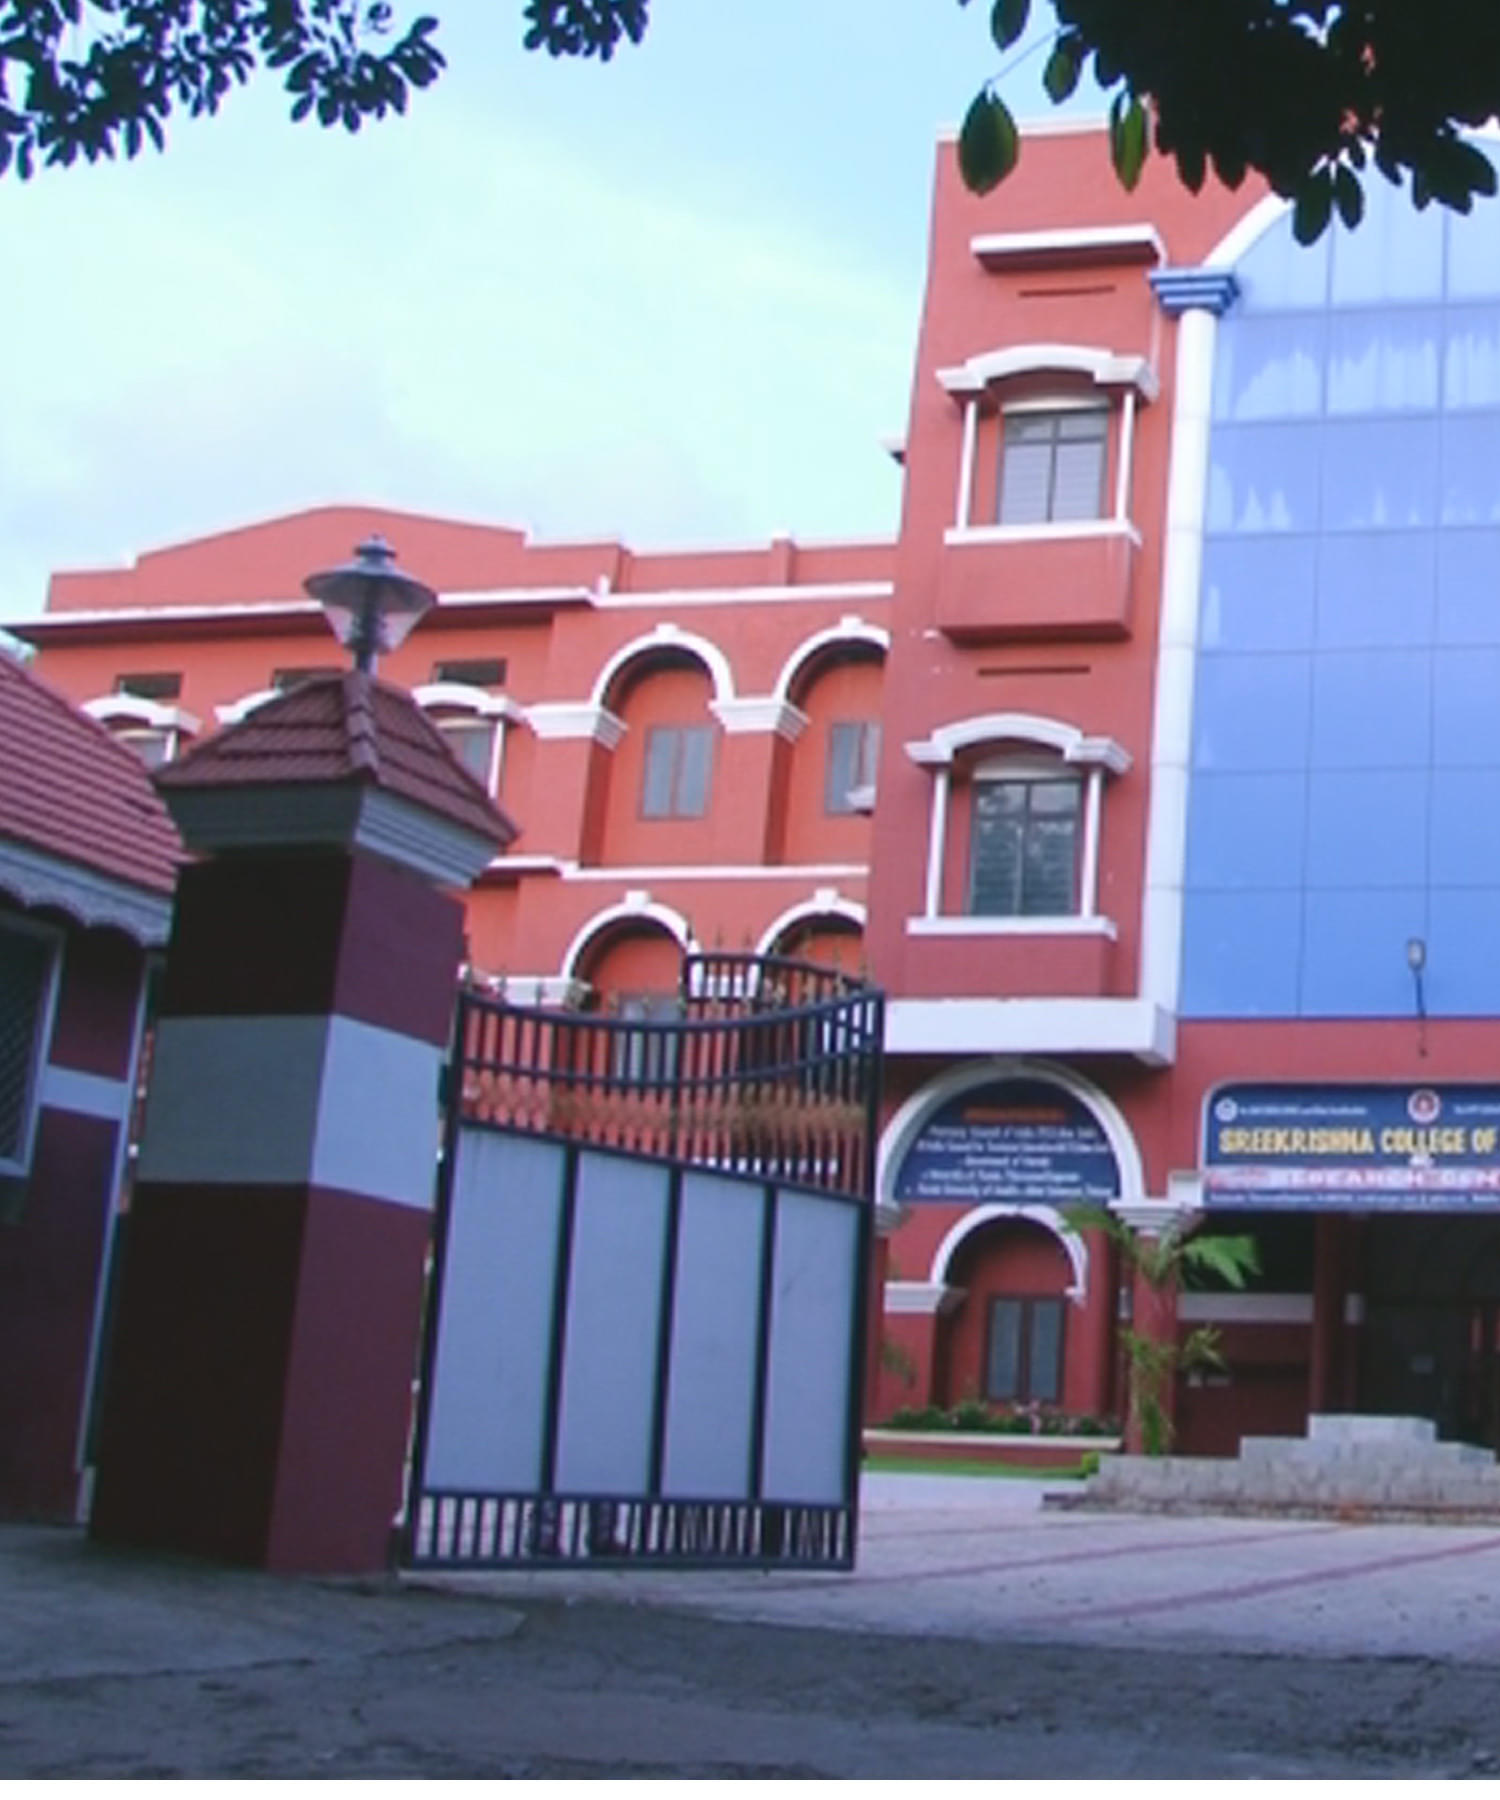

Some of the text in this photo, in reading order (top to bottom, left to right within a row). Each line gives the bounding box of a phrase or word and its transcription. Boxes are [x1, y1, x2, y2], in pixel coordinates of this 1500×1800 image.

[1219, 1128, 1375, 1154] SREEKRISHNA
[1380, 1128, 1465, 1153] COLLEGE
[1472, 1127, 1496, 1153] OF
